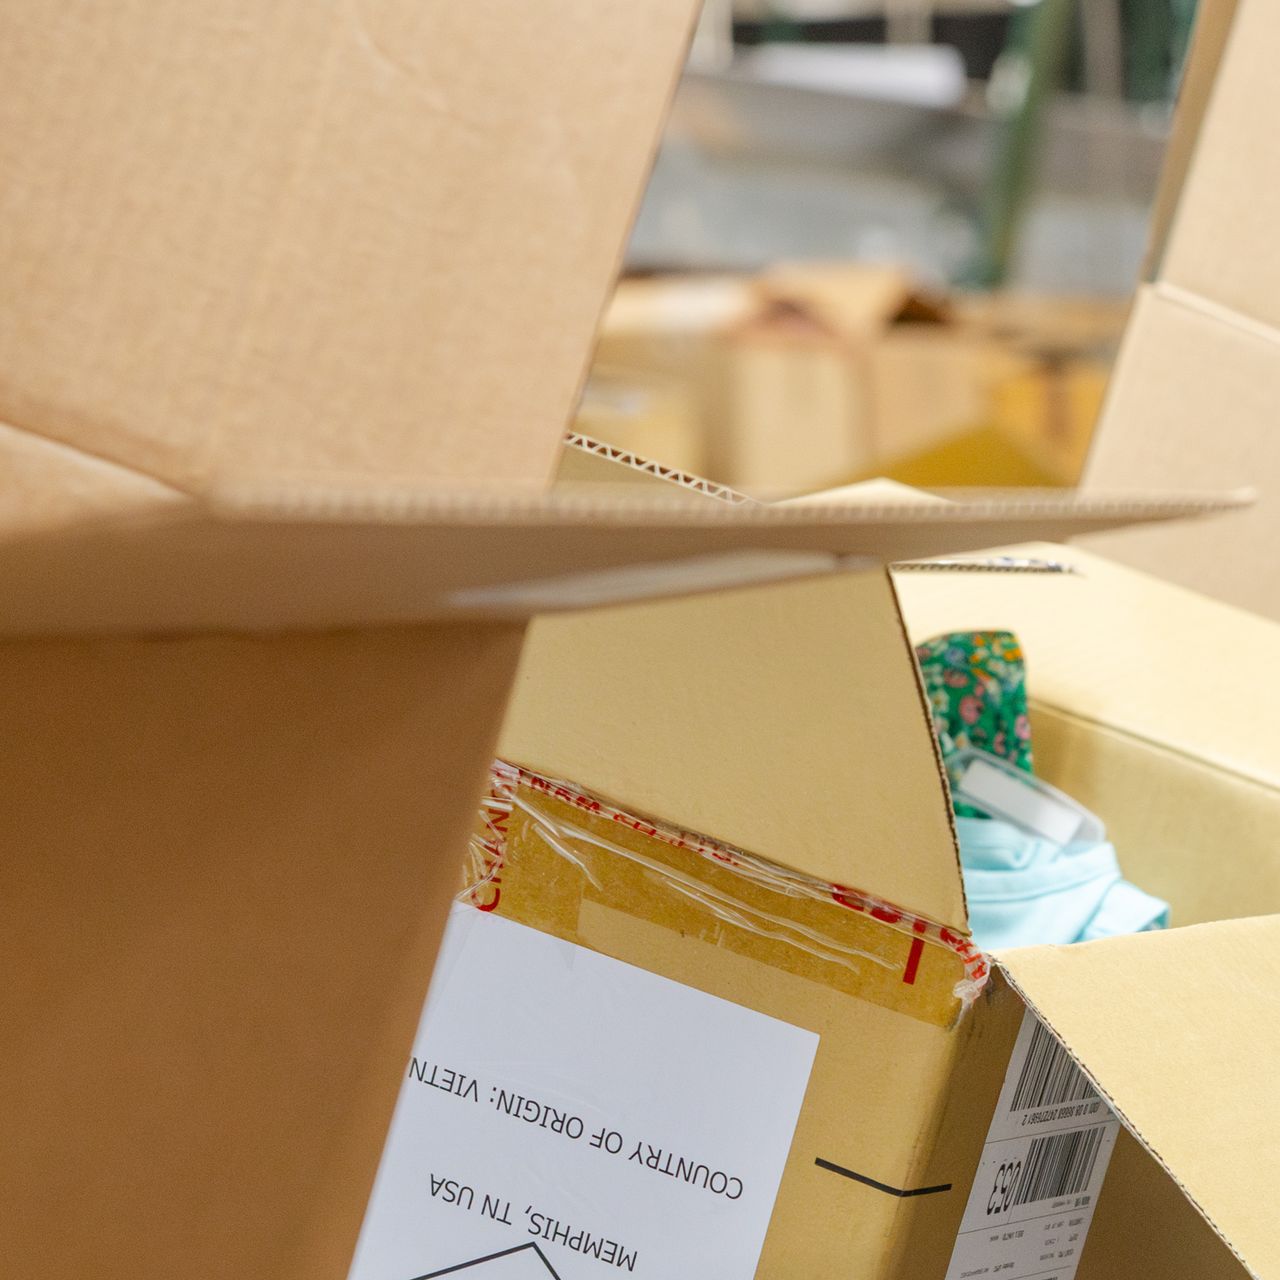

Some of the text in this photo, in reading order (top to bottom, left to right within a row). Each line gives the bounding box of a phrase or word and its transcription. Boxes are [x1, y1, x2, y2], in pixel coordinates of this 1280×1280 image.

[490, 1087, 583, 1138] ORIGIN:
[591, 1127, 624, 1152] OF
[629, 1140, 744, 1201] COUNTRY
[430, 1173, 637, 1272] MEMPHIS, TN USA
